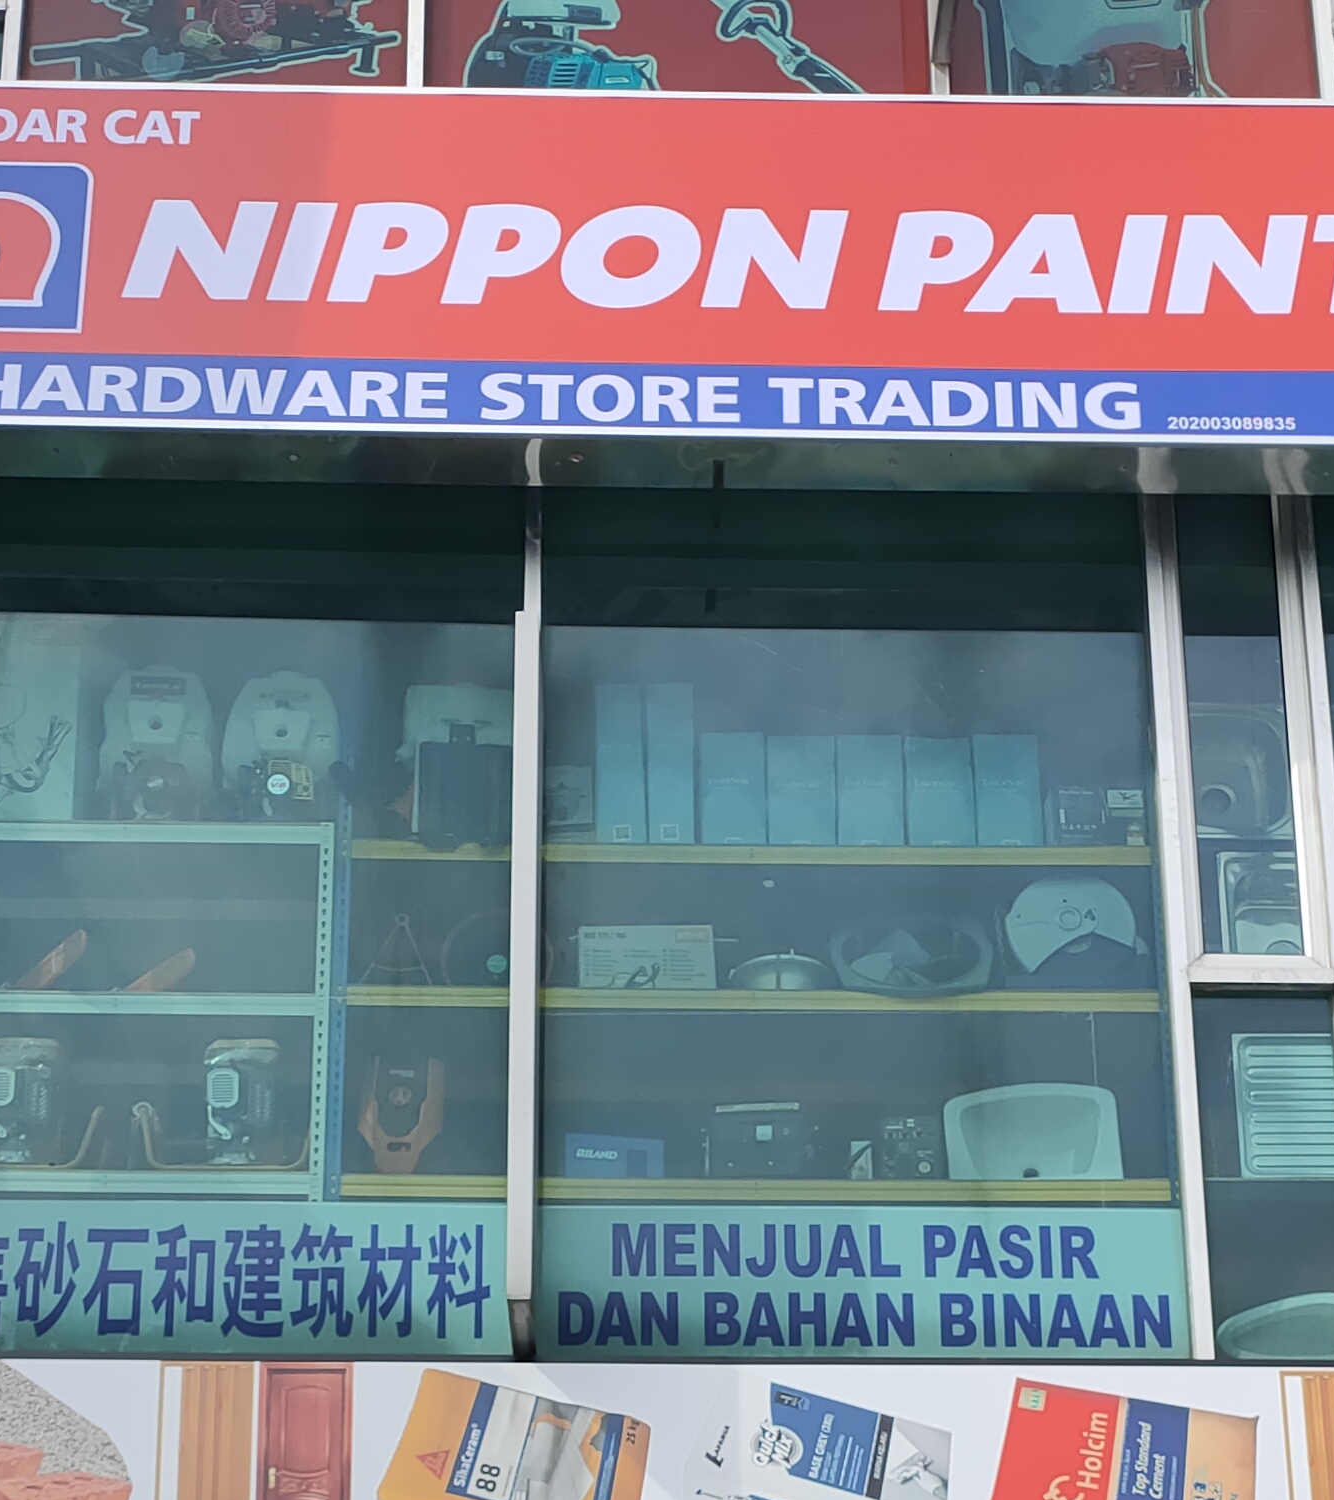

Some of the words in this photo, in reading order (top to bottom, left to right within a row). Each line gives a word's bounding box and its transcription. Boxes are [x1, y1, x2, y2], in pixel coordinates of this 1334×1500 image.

[103, 109, 201, 145] CAT
[121, 199, 850, 310] NIPPON
[479, 371, 742, 424] STORE
[768, 377, 1142, 431] TRADING
[1167, 416, 1297, 431] 202003089835
[612, 1223, 901, 1279] MENJUAL
[923, 1225, 1100, 1280] PASIR
[557, 1291, 679, 1347] DAN
[704, 1291, 916, 1348] BAHAN
[940, 1294, 1173, 1349] BINAAN
[1076, 1410, 1110, 1491] Holcim
[1134, 1420, 1153, 1471] Standard
[476, 1463, 501, 1493] 88
[1132, 1473, 1147, 1497] Top
[1148, 1453, 1167, 1500] Cement
